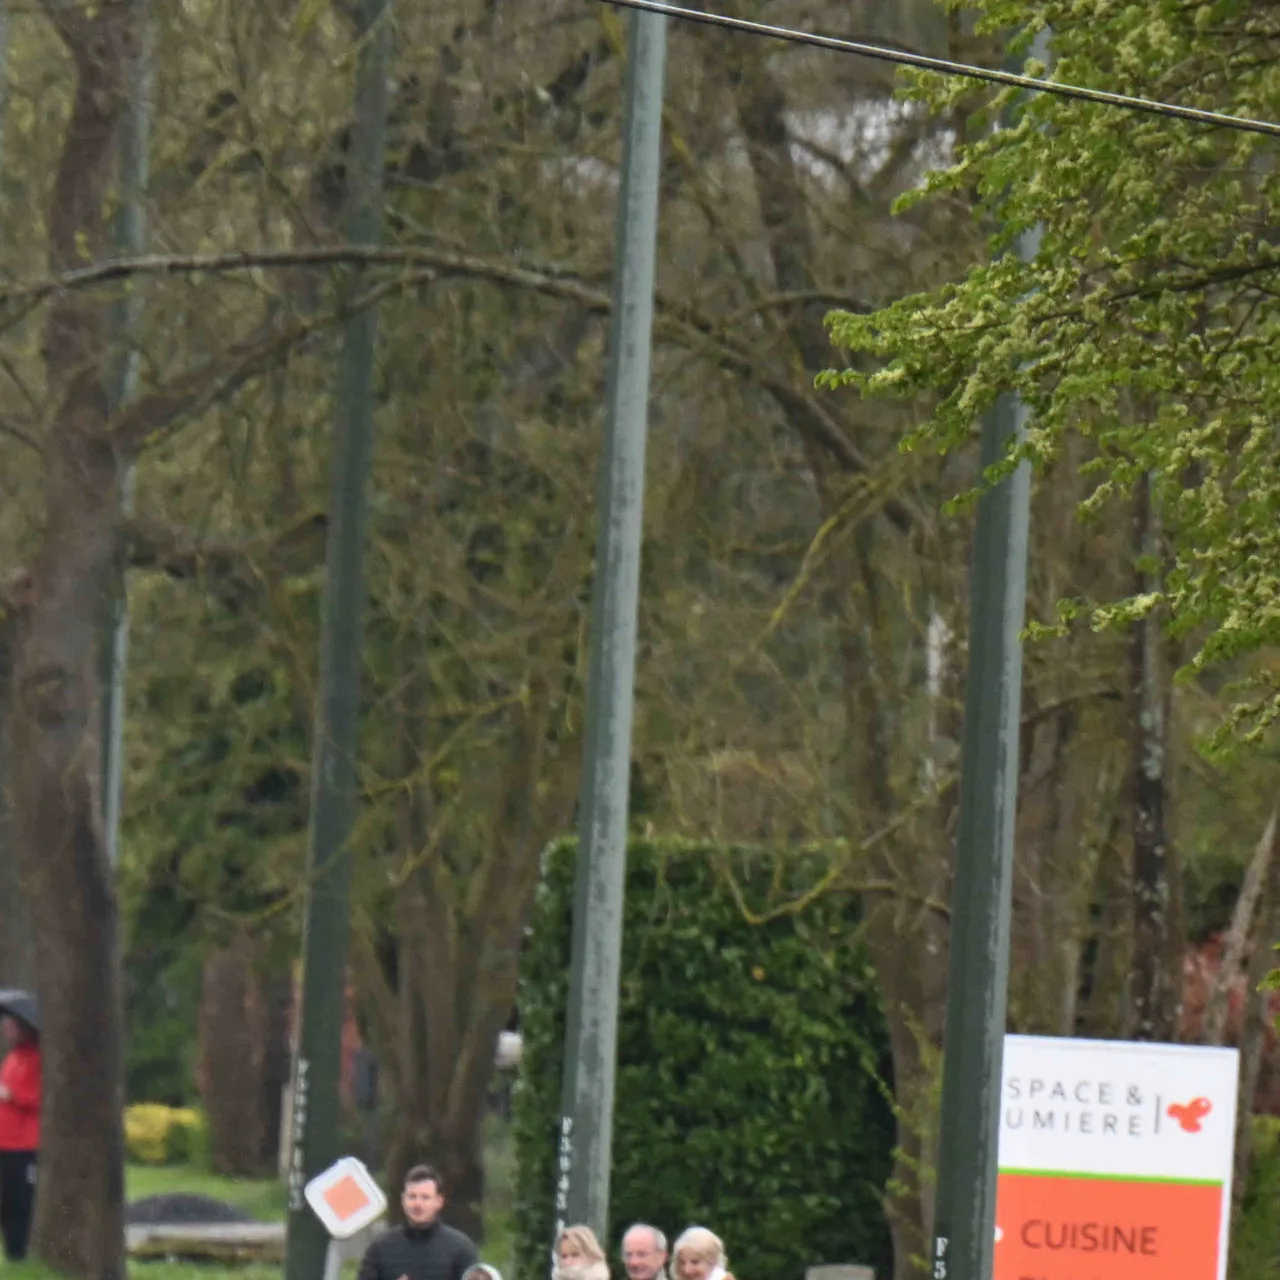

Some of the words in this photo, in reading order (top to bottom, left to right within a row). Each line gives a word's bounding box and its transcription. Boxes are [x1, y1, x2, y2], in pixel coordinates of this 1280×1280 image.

[1007, 1077, 1113, 1105] SPACE
[1126, 1085, 1143, 1106] &
[1005, 1108, 1144, 1136] UMIERE
[1021, 1219, 1158, 1255] CUISINE
